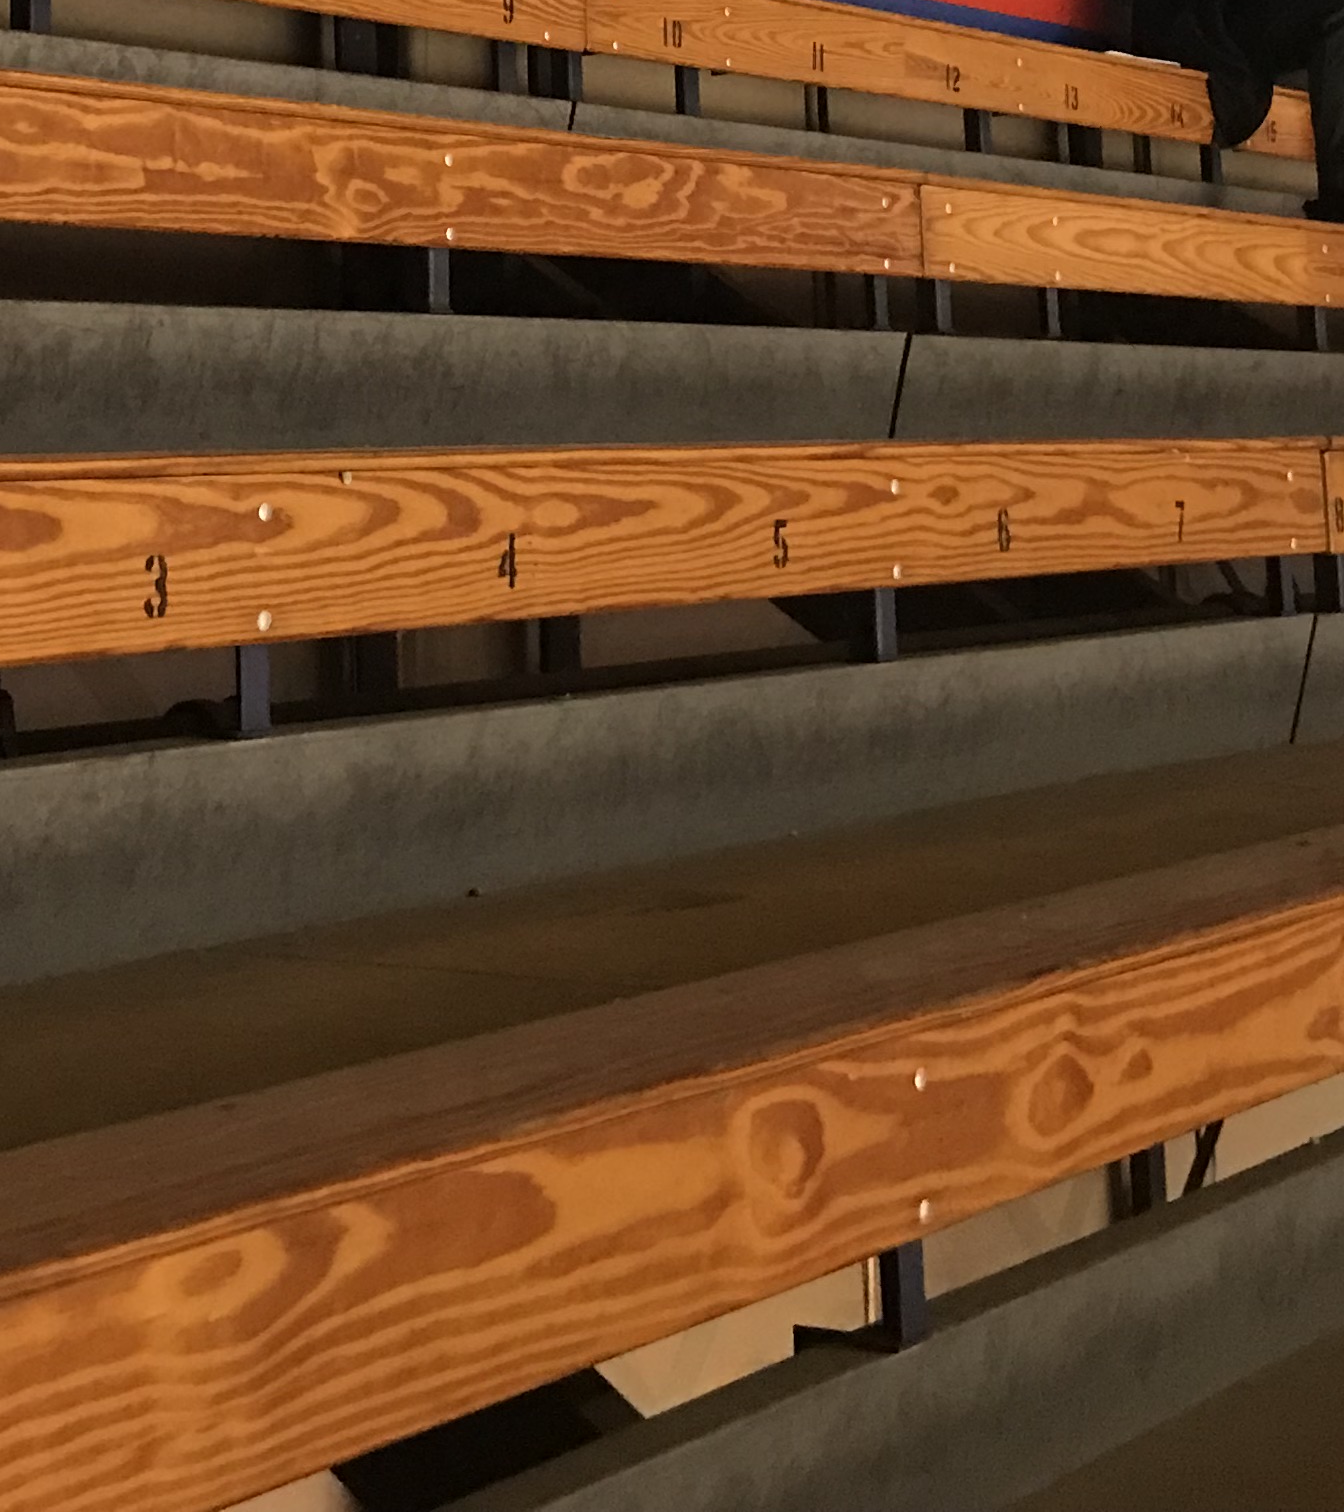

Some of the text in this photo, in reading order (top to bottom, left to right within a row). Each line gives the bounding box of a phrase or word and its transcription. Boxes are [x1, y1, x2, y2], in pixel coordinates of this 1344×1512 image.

[662, 17, 684, 50] 10
[811, 40, 826, 73] 11
[944, 63, 961, 93] 12
[1174, 499, 1185, 543] 7
[497, 532, 518, 590] 4
[773, 518, 789, 569] 5
[144, 554, 169, 619] 3
